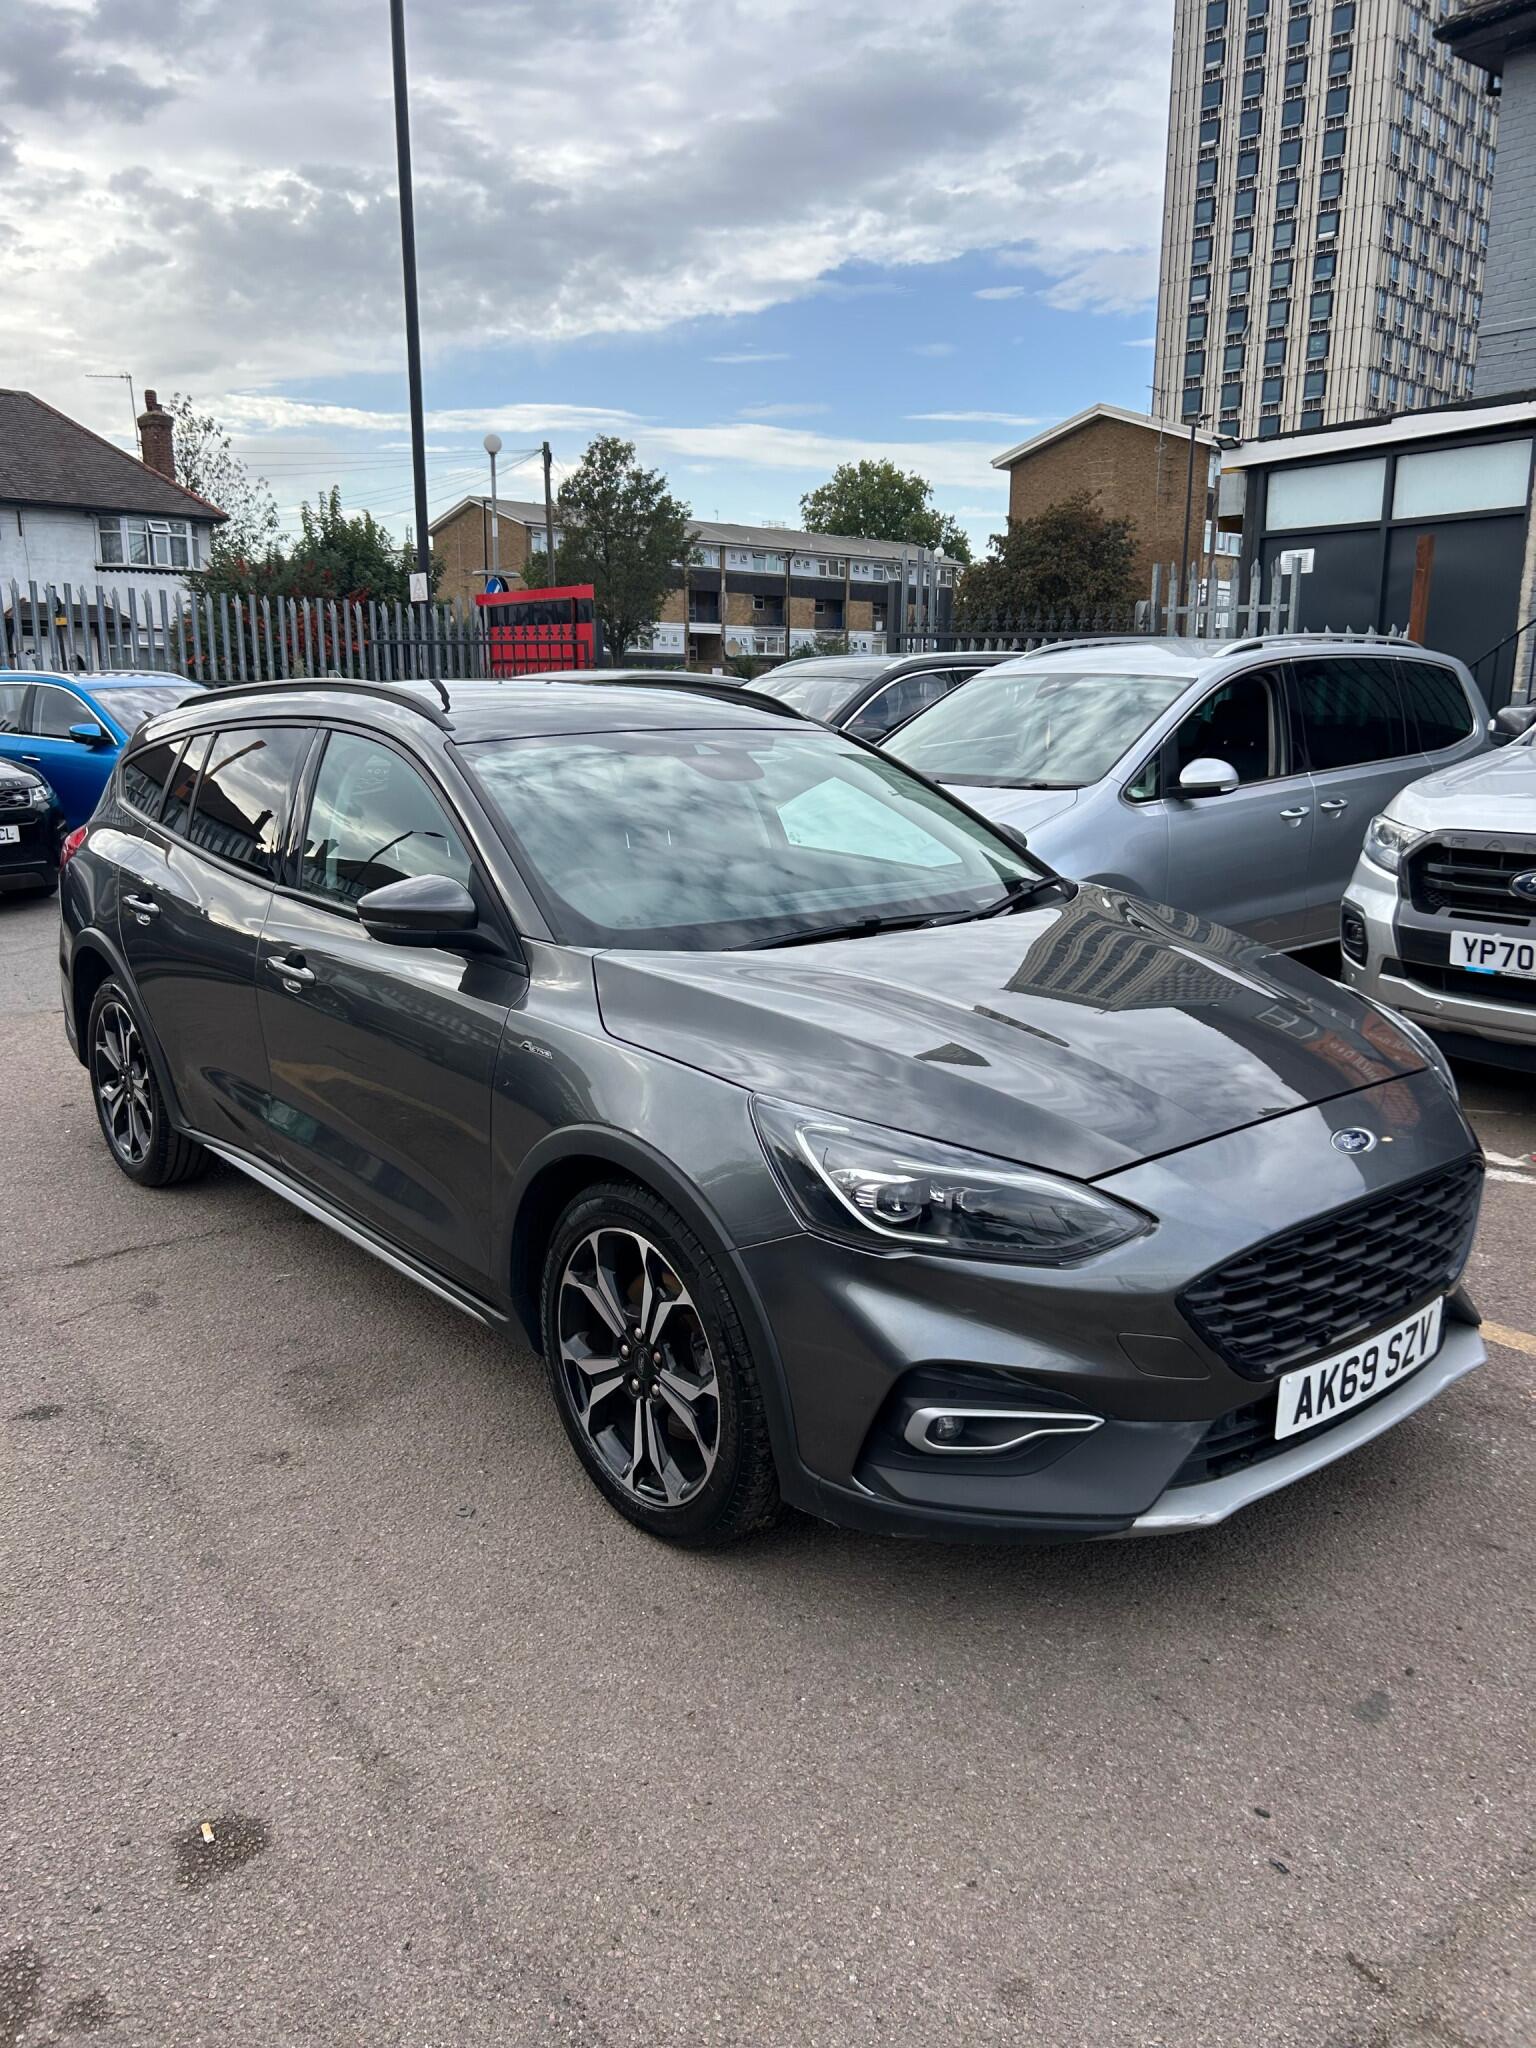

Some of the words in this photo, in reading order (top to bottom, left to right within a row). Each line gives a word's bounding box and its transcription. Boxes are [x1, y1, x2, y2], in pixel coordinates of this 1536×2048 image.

[1463, 937, 1534, 970] YP70
[1293, 1345, 1380, 1425] AK69
[1385, 1310, 1434, 1379] SZV
